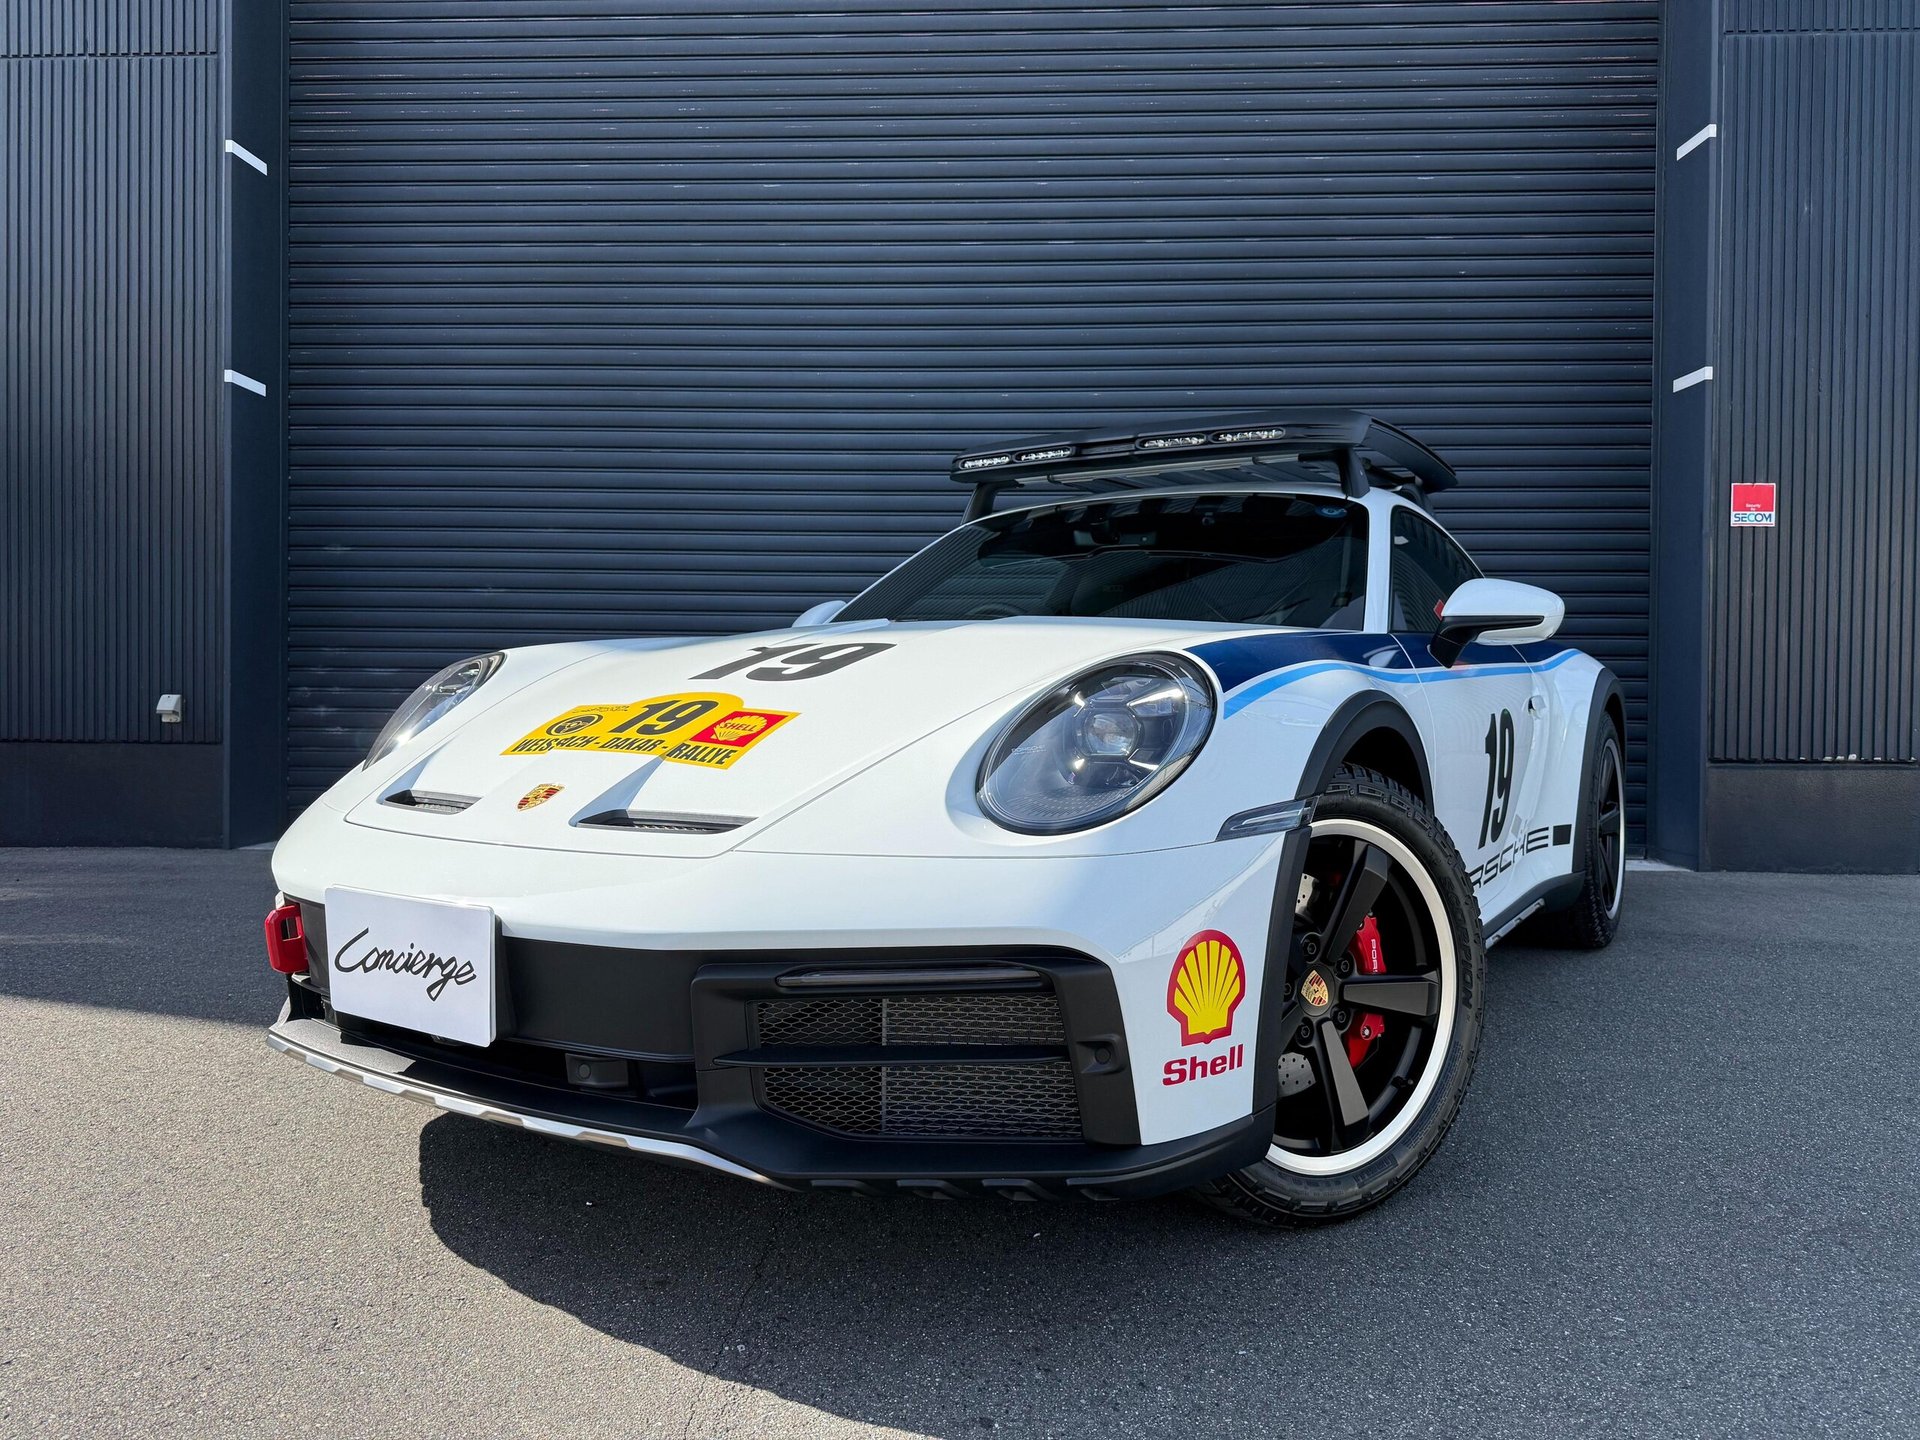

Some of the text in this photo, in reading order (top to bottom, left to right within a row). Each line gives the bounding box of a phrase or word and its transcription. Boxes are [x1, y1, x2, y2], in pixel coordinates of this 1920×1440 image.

[1733, 513, 1772, 522] SECOM
[688, 642, 898, 682] 19
[609, 699, 720, 736] 19
[719, 722, 757, 732] SHELL
[598, 737, 664, 752] DAKAR
[665, 742, 739, 765] RALLYE
[1477, 708, 1515, 850] 19
[334, 927, 477, 1002] Concierge
[1162, 1043, 1244, 1087] Shell
